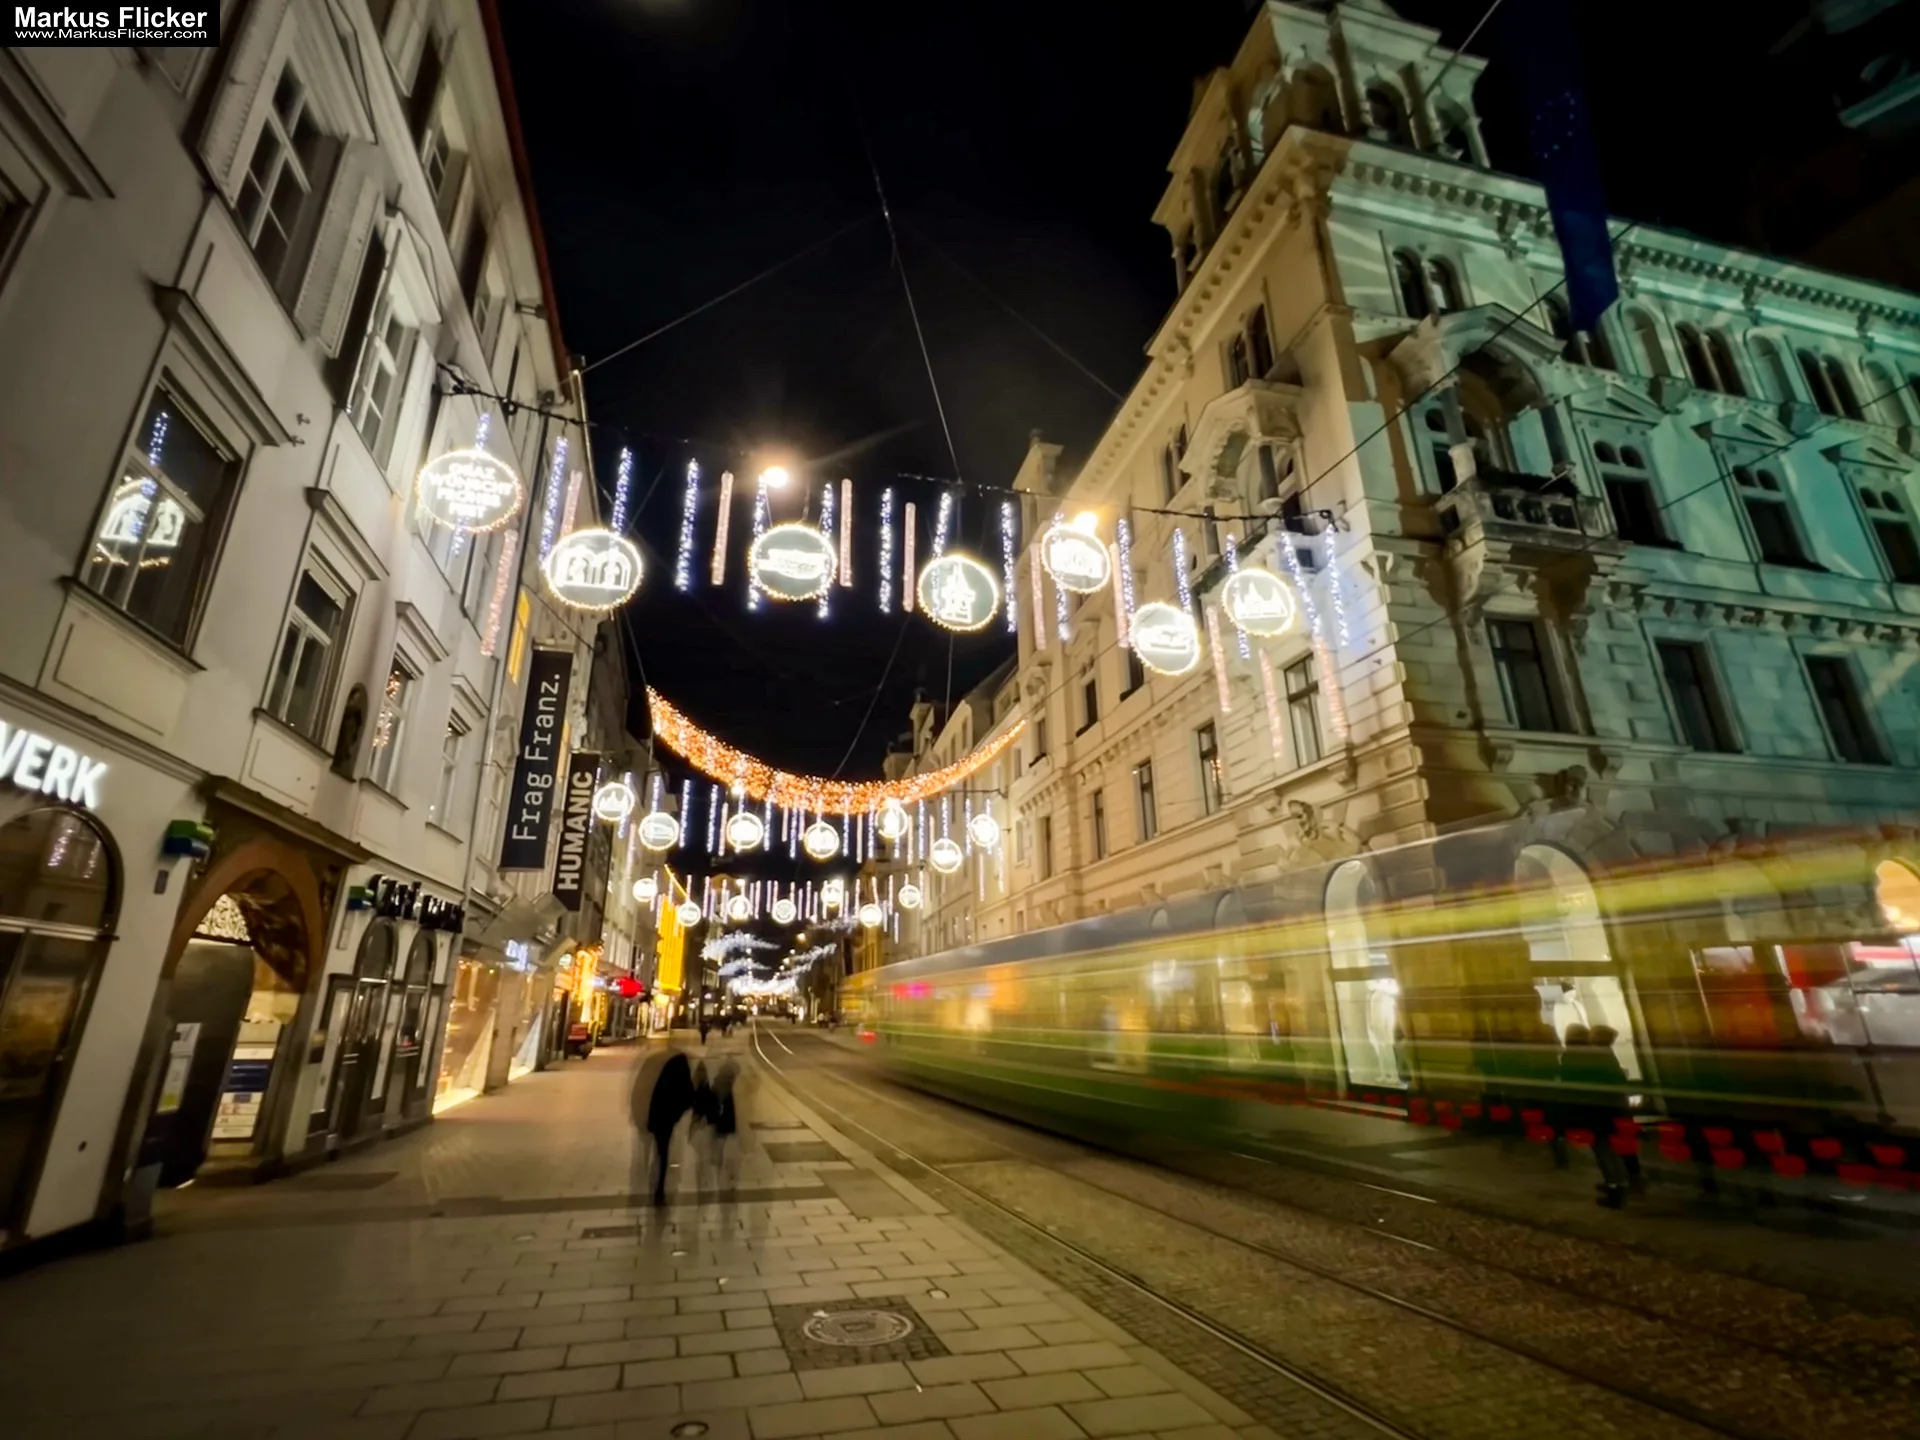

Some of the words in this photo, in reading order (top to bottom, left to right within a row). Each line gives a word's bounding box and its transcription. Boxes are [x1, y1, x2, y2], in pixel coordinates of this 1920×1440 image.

[525, 673, 561, 761] Franz.
[512, 774, 552, 840] Frag
[558, 771, 593, 890] HUMANIC
